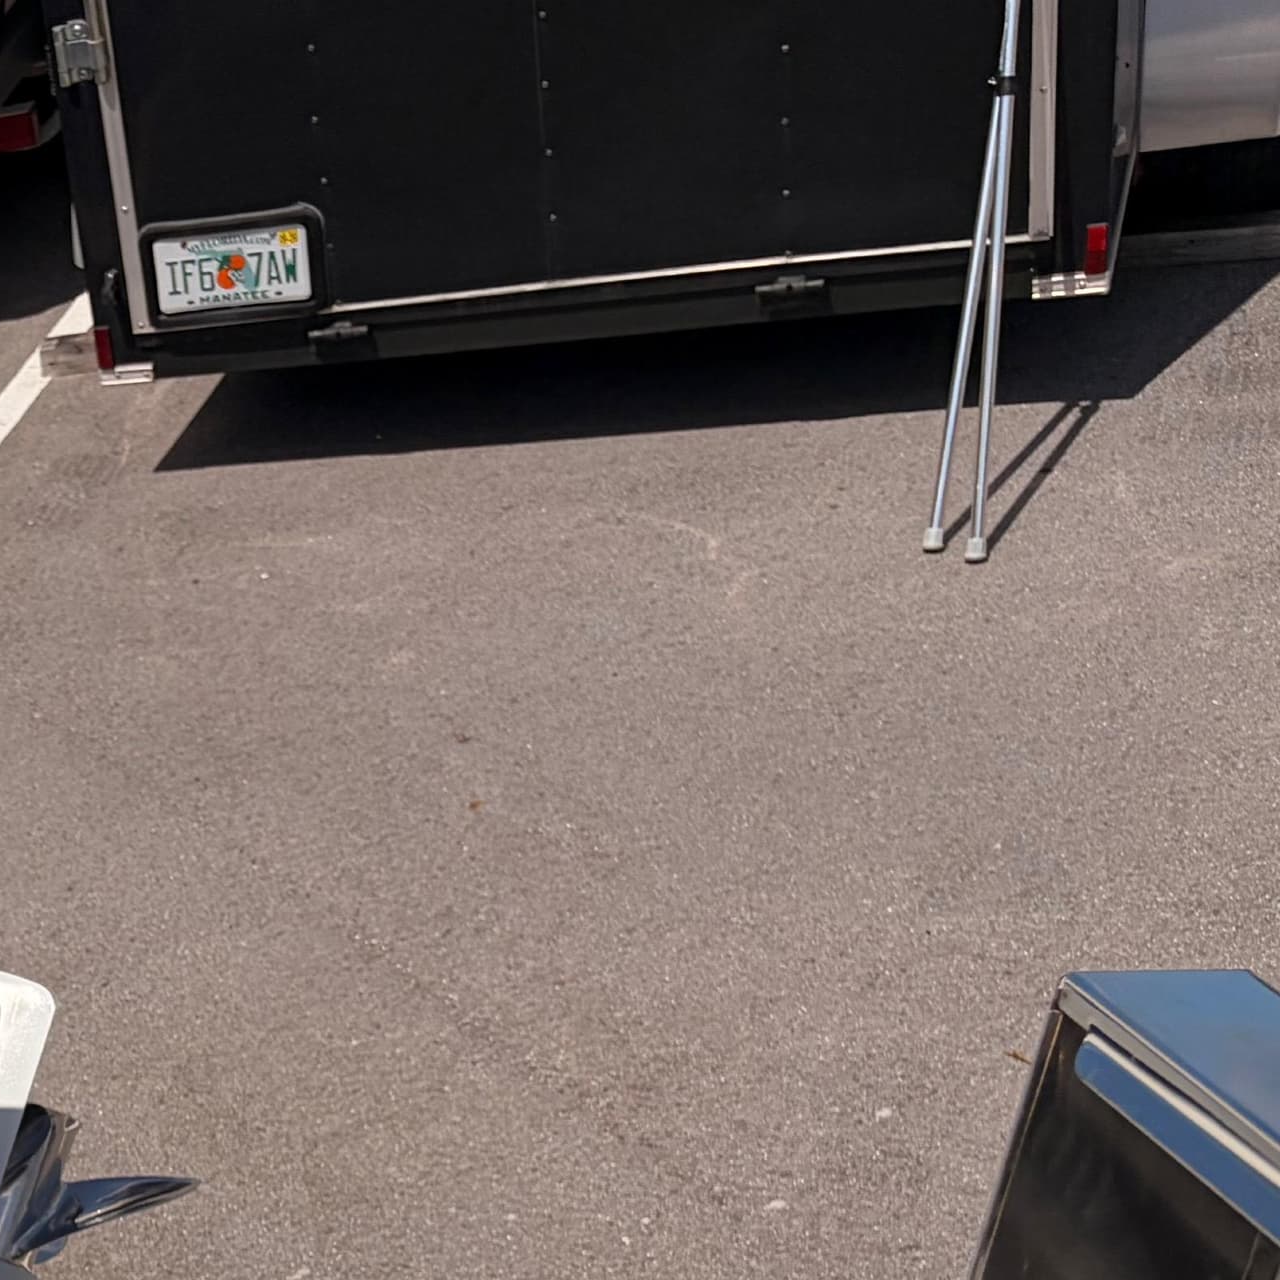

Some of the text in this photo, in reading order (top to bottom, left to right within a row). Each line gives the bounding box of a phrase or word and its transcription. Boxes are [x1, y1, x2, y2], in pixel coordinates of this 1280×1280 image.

[165, 248, 298, 296] IF6 7AW
[199, 289, 270, 305] MANATEE
